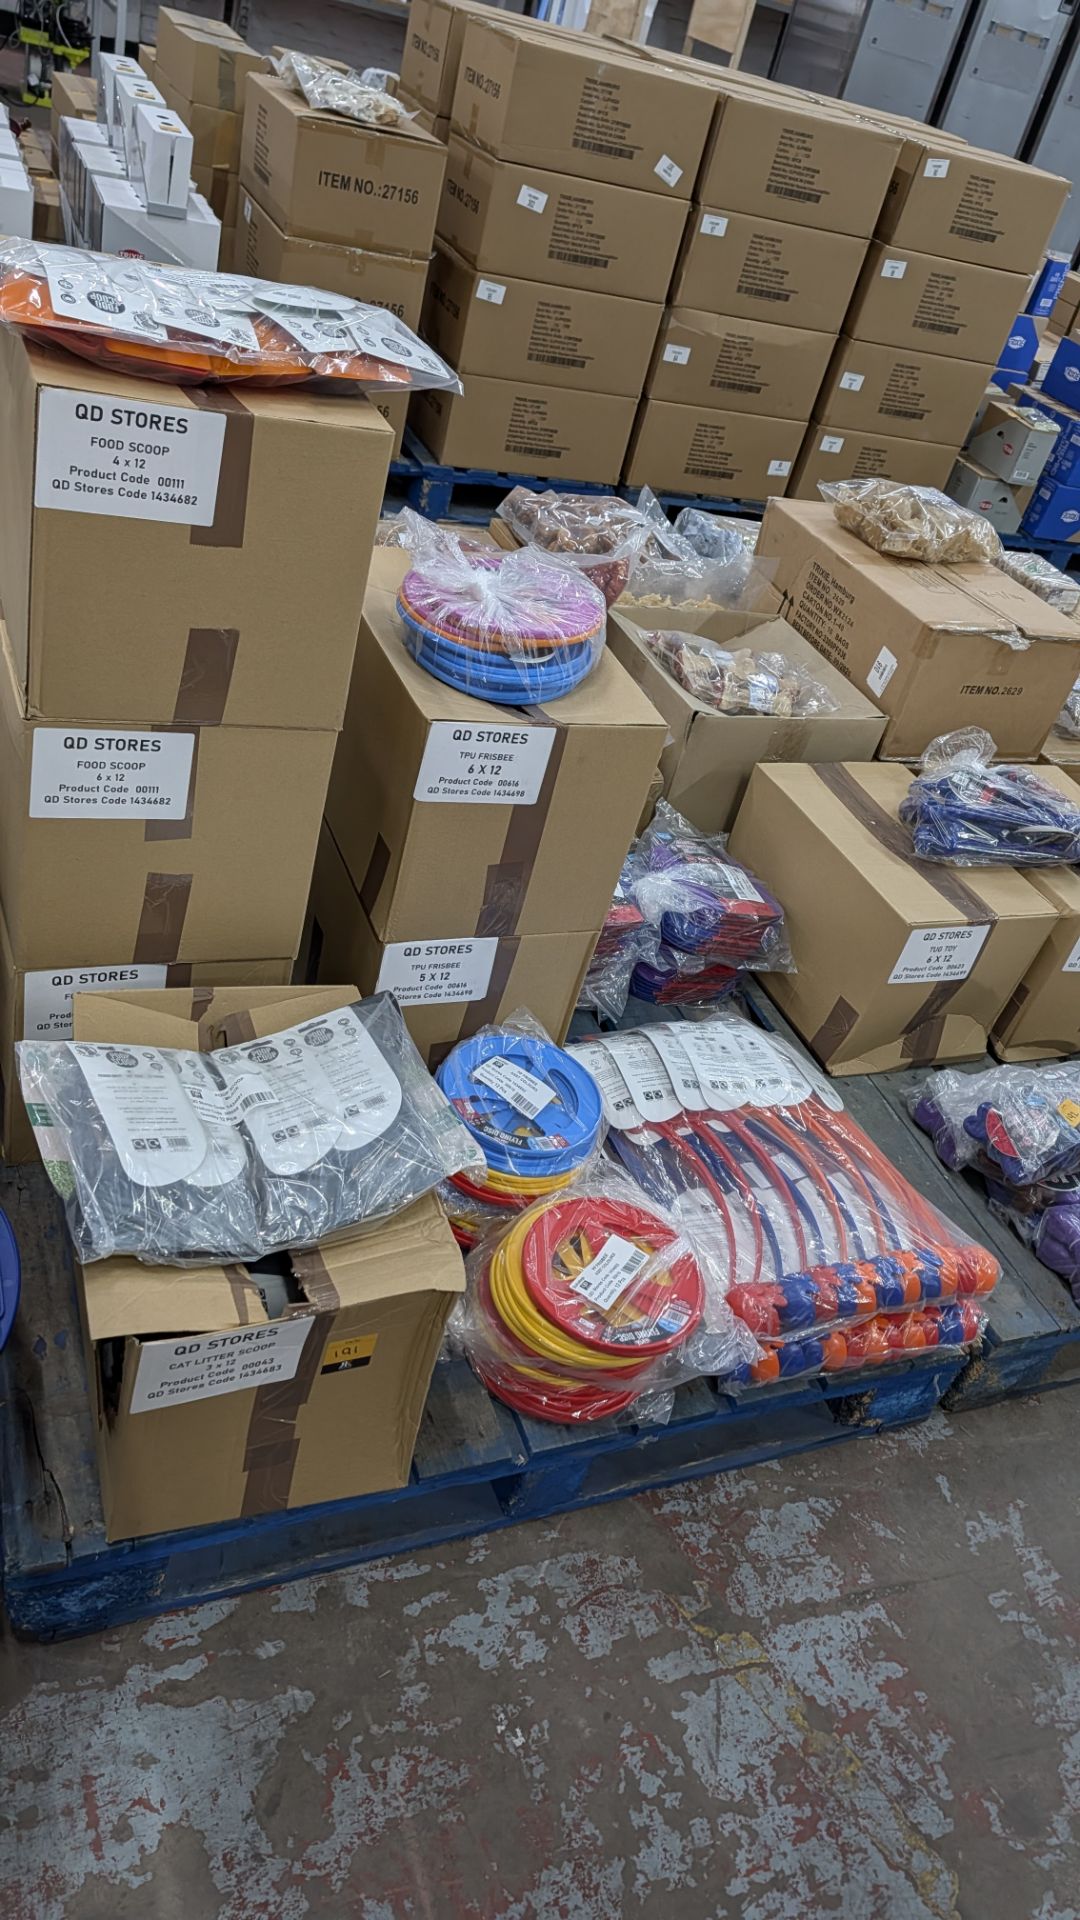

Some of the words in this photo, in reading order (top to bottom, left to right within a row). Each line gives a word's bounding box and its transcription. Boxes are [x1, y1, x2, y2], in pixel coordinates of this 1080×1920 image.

[318, 170, 351, 190] ITEM
[75, 403, 103, 423] QD
[111, 408, 189, 435] STORES
[90, 436, 124, 451] FOOD
[128, 440, 170, 456] SCOOP
[112, 456, 120, 467] 4
[134, 457, 146, 469] 12
[69, 466, 117, 482] Product
[121, 471, 150, 485] Code
[157, 477, 185, 490] 00111
[52, 478, 70, 492] QD
[74, 481, 114, 496] Stores
[117, 487, 148, 501] Code
[150, 491, 198, 506] 1434682
[960, 685, 982, 695] ITEM
[452, 730, 472, 742] QD
[476, 731, 529, 745] STORES
[63, 737, 88, 752] QD
[94, 738, 162, 753] STORES
[459, 752, 476, 760] TPU
[478, 753, 515, 762] FRISBEE
[77, 760, 106, 770] FOOD
[109, 761, 146, 771] SCOOP
[467, 764, 475, 774] 6
[479, 765, 488, 775] X
[490, 765, 502, 776] 12
[96, 773, 103, 782] 6
[115, 773, 125, 782] 12
[438, 777, 471, 786] Product
[473, 778, 493, 787] Code
[59, 783, 100, 794] Product
[103, 784, 129, 794] Code
[135, 785, 160, 794] 00111
[427, 786, 440, 795] QD
[442, 787, 469, 796] Stores
[471, 788, 491, 797] Code
[44, 795, 60, 805] QD
[63, 795, 98, 805] Stores
[101, 796, 127, 805] Code
[130, 796, 172, 806] 1434682
[923, 933, 937, 941] QD
[937, 930, 973, 940] STORES
[403, 947, 421, 957] QD
[425, 944, 473, 955] STORES
[926, 956, 932, 964] 6
[933, 955, 941, 963] X
[943, 955, 952, 963] 12
[427, 961, 461, 971] FRISBEE
[52, 975, 73, 986] QD
[79, 969, 139, 984] STORES
[420, 973, 426, 982] 5
[429, 972, 437, 981] X
[440, 972, 451, 981] 12
[393, 985, 423, 993] Product
[425, 983, 443, 991] Code
[397, 992, 422, 1001] Stores
[423, 990, 442, 998] Code
[49, 1012, 73, 1020] Prod
[174, 1344, 200, 1356] QD
[206, 1328, 279, 1350] STORES
[169, 1360, 190, 1371] CAT
[193, 1351, 235, 1367] LITTER
[238, 1342, 276, 1356] SCOOP
[206, 1363, 214, 1371] 3
[225, 1358, 236, 1367] 12
[160, 1374, 204, 1388] Product
[207, 1367, 235, 1379] Code
[241, 1357, 274, 1371] 00043
[147, 1390, 164, 1399] QD
[168, 1383, 205, 1396] Stores
[208, 1375, 235, 1386] Code
[239, 1364, 282, 1380] 1434683
